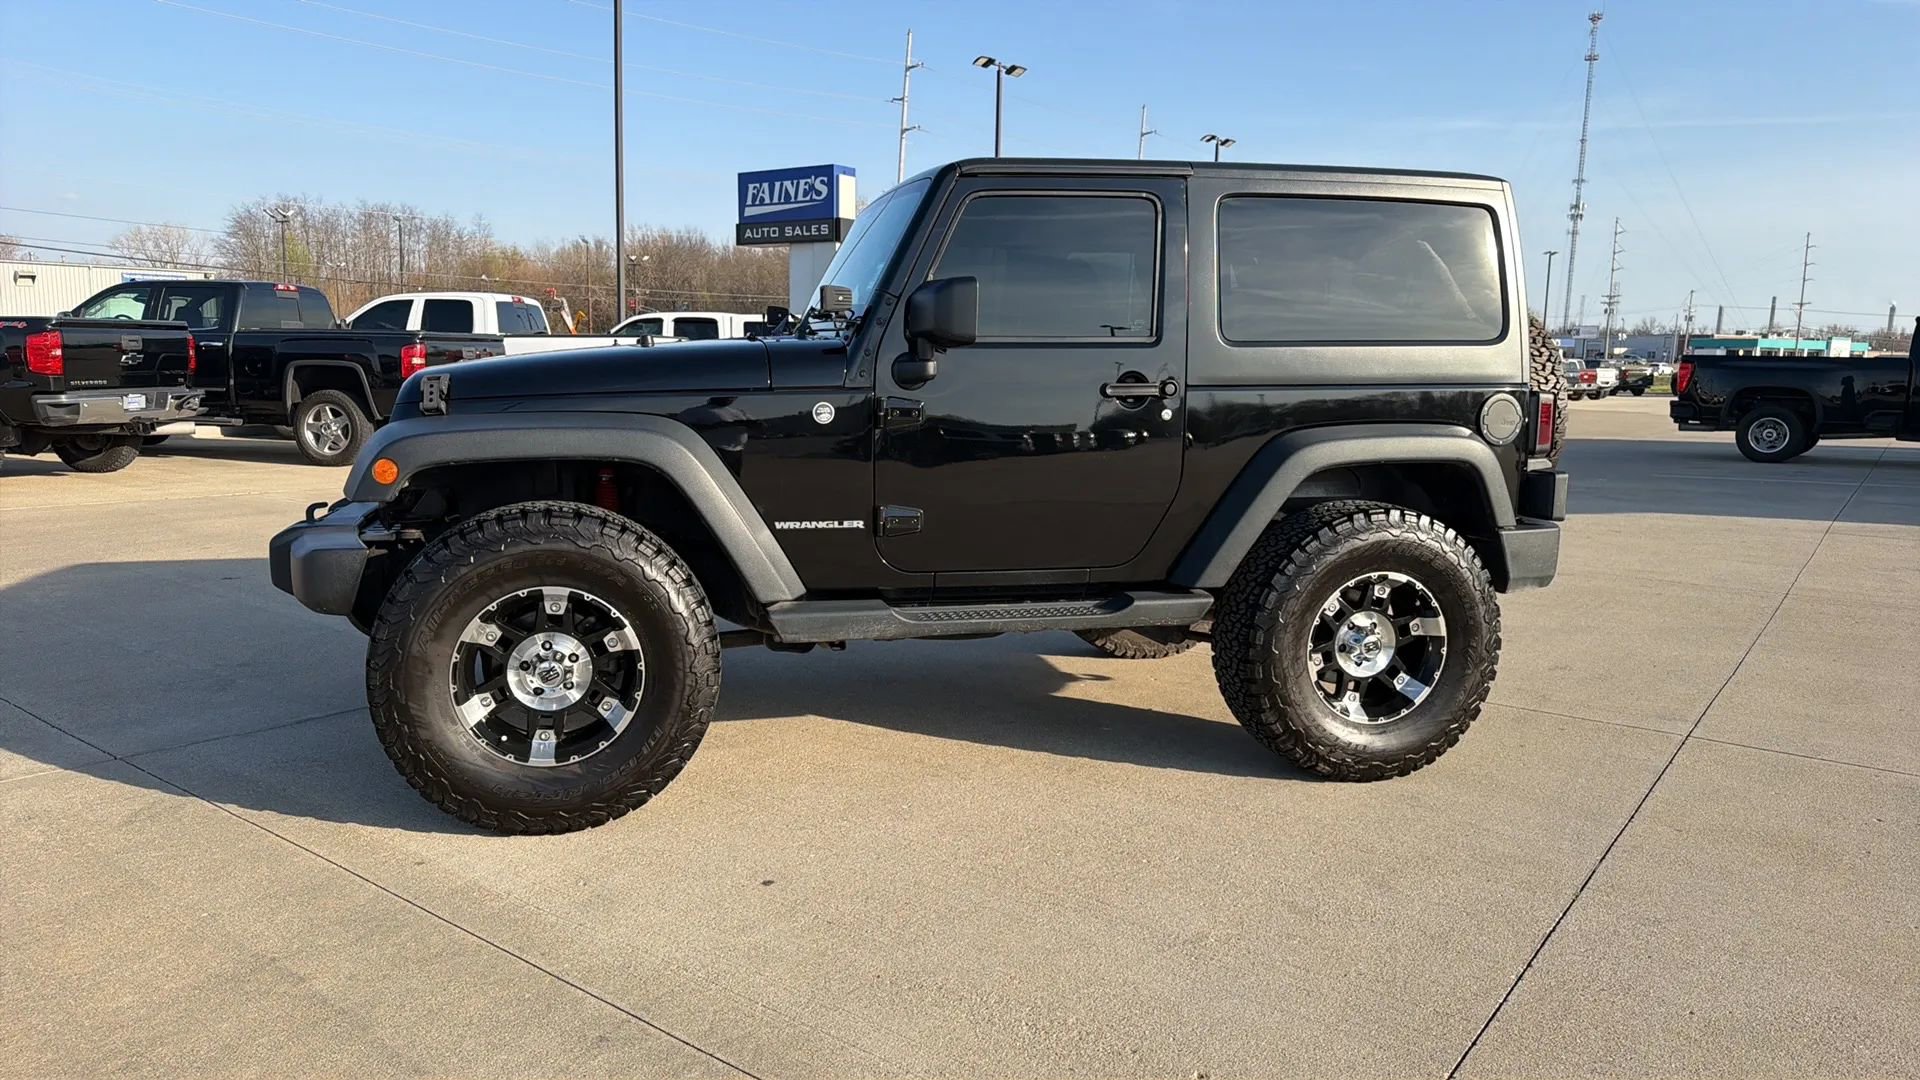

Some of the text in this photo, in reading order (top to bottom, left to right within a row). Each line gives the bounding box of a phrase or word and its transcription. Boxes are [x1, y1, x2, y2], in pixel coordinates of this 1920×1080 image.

[745, 175, 829, 206] FAINE'S
[744, 224, 829, 239] AUTO SALES
[774, 520, 865, 529] WRANGLER
